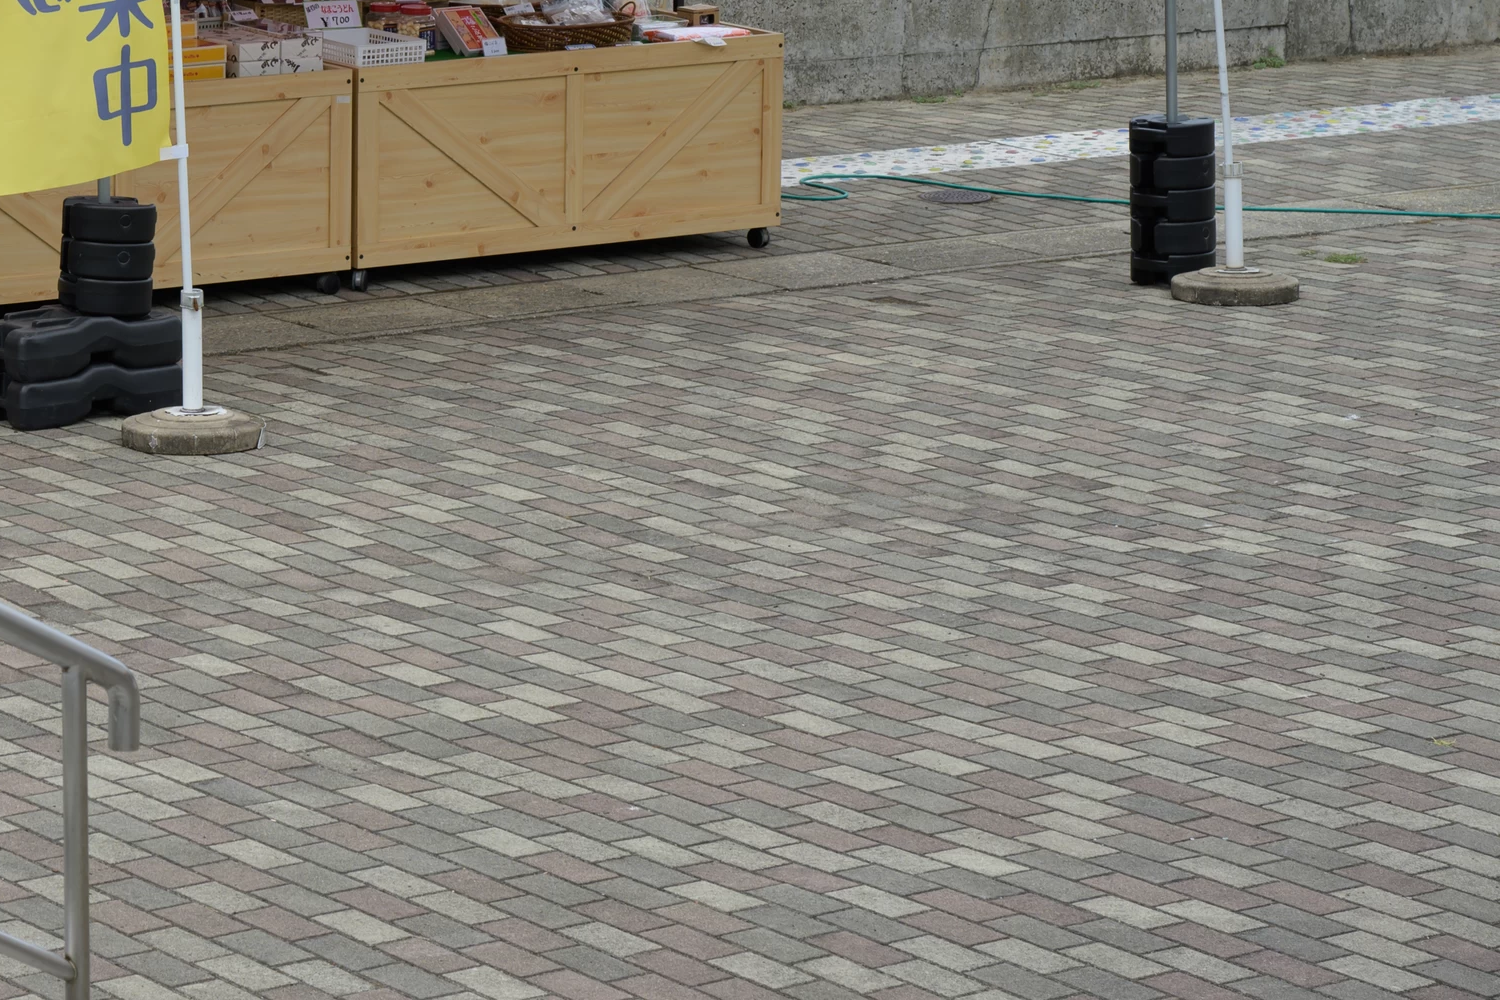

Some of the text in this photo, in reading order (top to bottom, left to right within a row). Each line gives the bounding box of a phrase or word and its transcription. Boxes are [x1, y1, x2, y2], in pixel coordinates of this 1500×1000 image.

[320, 4, 355, 14] なまこうどん
